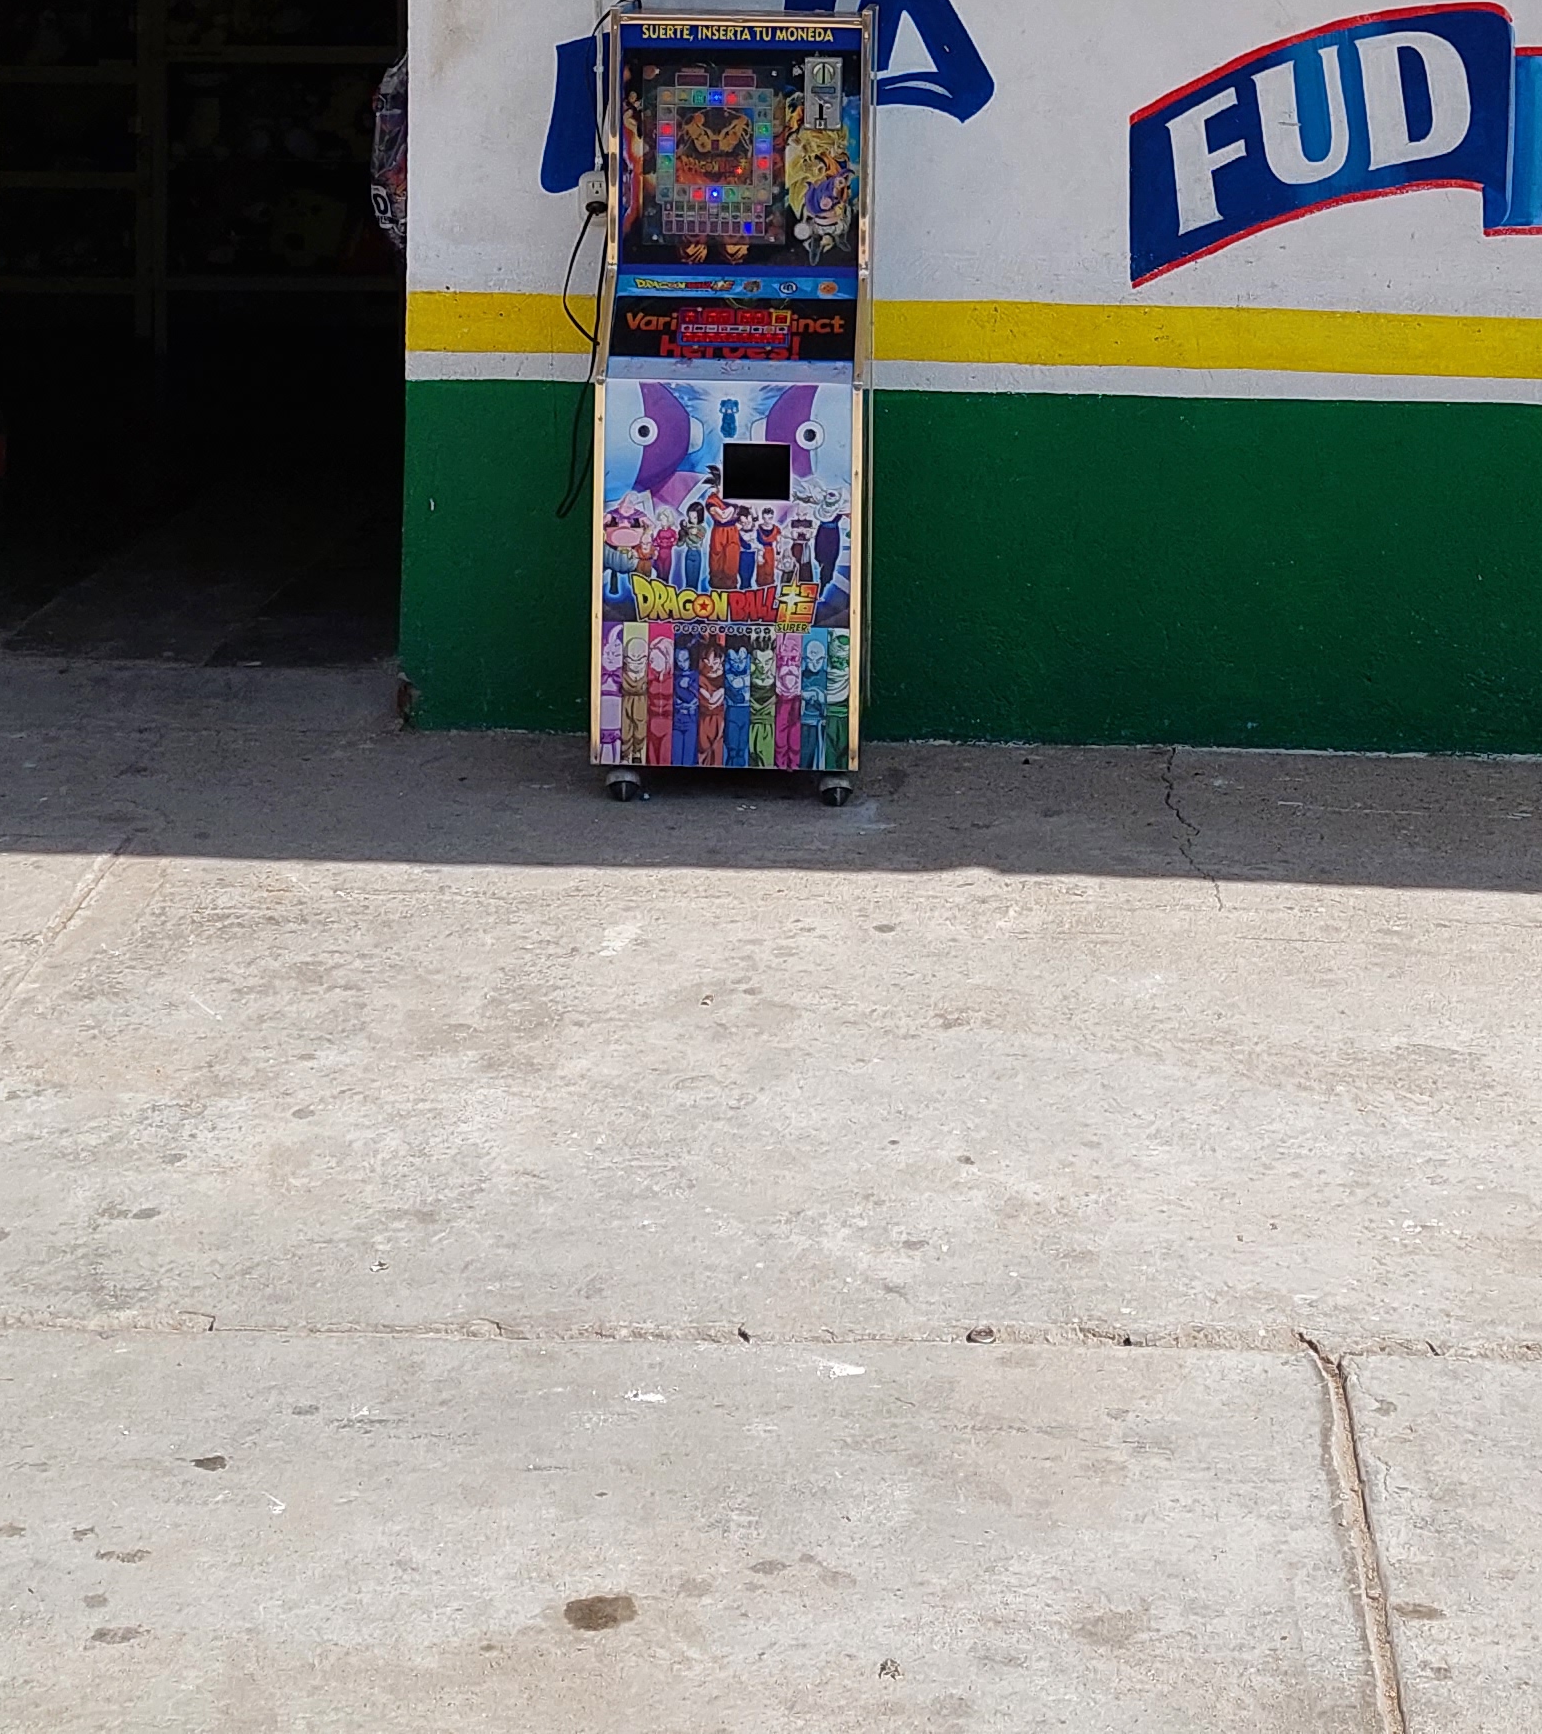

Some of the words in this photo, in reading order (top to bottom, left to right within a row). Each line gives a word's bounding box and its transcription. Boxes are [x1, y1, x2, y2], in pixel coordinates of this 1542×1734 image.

[698, 26, 750, 41] INSERTA
[753, 27, 772, 41] TU
[775, 27, 834, 42] MONEDA
[1164, 30, 1472, 237] FUD
[632, 574, 729, 622] DRAGON
[729, 585, 778, 623] BALL
[776, 623, 809, 633] SUPER
